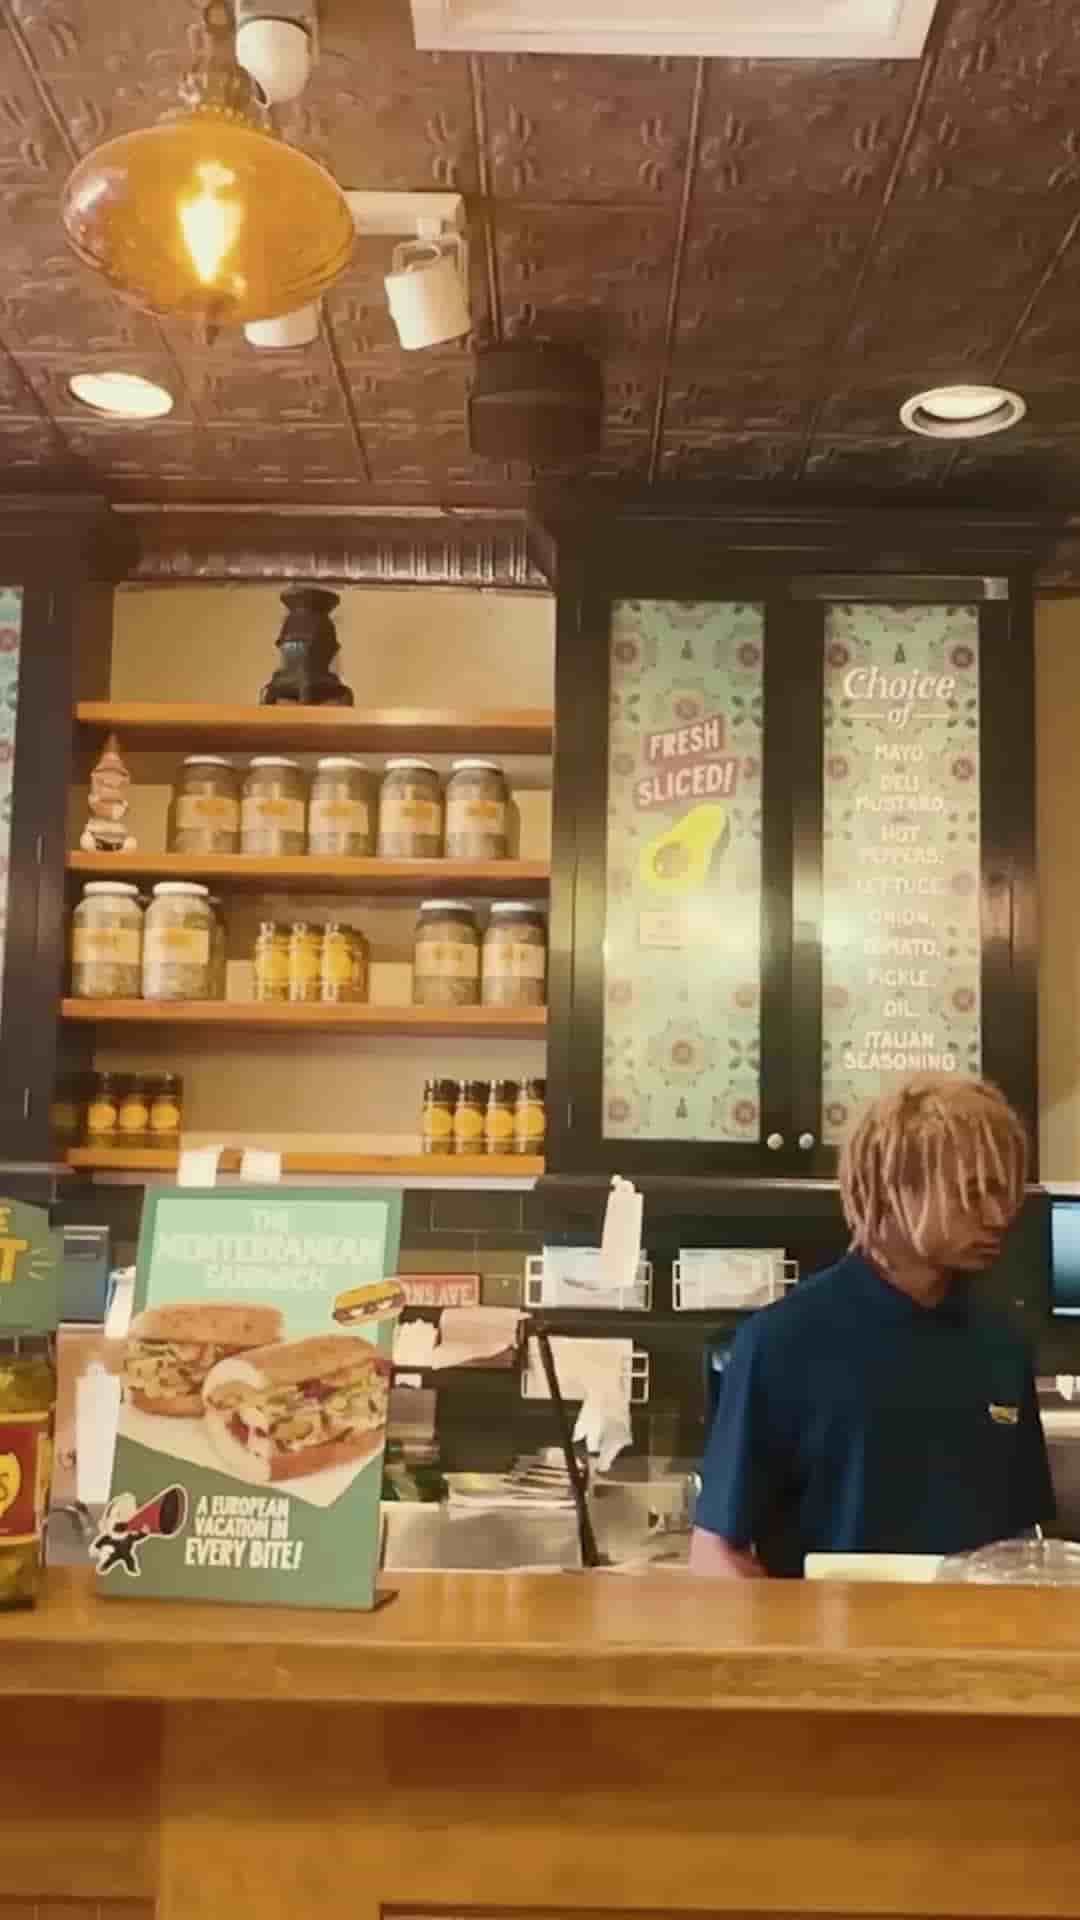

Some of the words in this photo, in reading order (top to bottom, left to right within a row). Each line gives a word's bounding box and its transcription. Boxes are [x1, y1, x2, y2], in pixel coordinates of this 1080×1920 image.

[844, 665, 956, 699] Choice
[888, 700, 912, 729] of
[648, 719, 720, 760] FRESH
[638, 761, 735, 807] SLICED!
[865, 1031, 936, 1050] ITALIAN
[845, 1050, 957, 1072] SEASONING
[196, 1496, 208, 1516] A
[211, 1496, 289, 1518] EUROPEAN
[195, 1517, 269, 1538] VACATION
[271, 1519, 289, 1539] IN
[184, 1537, 248, 1569] EVERY
[248, 1540, 304, 1571] BITE!
